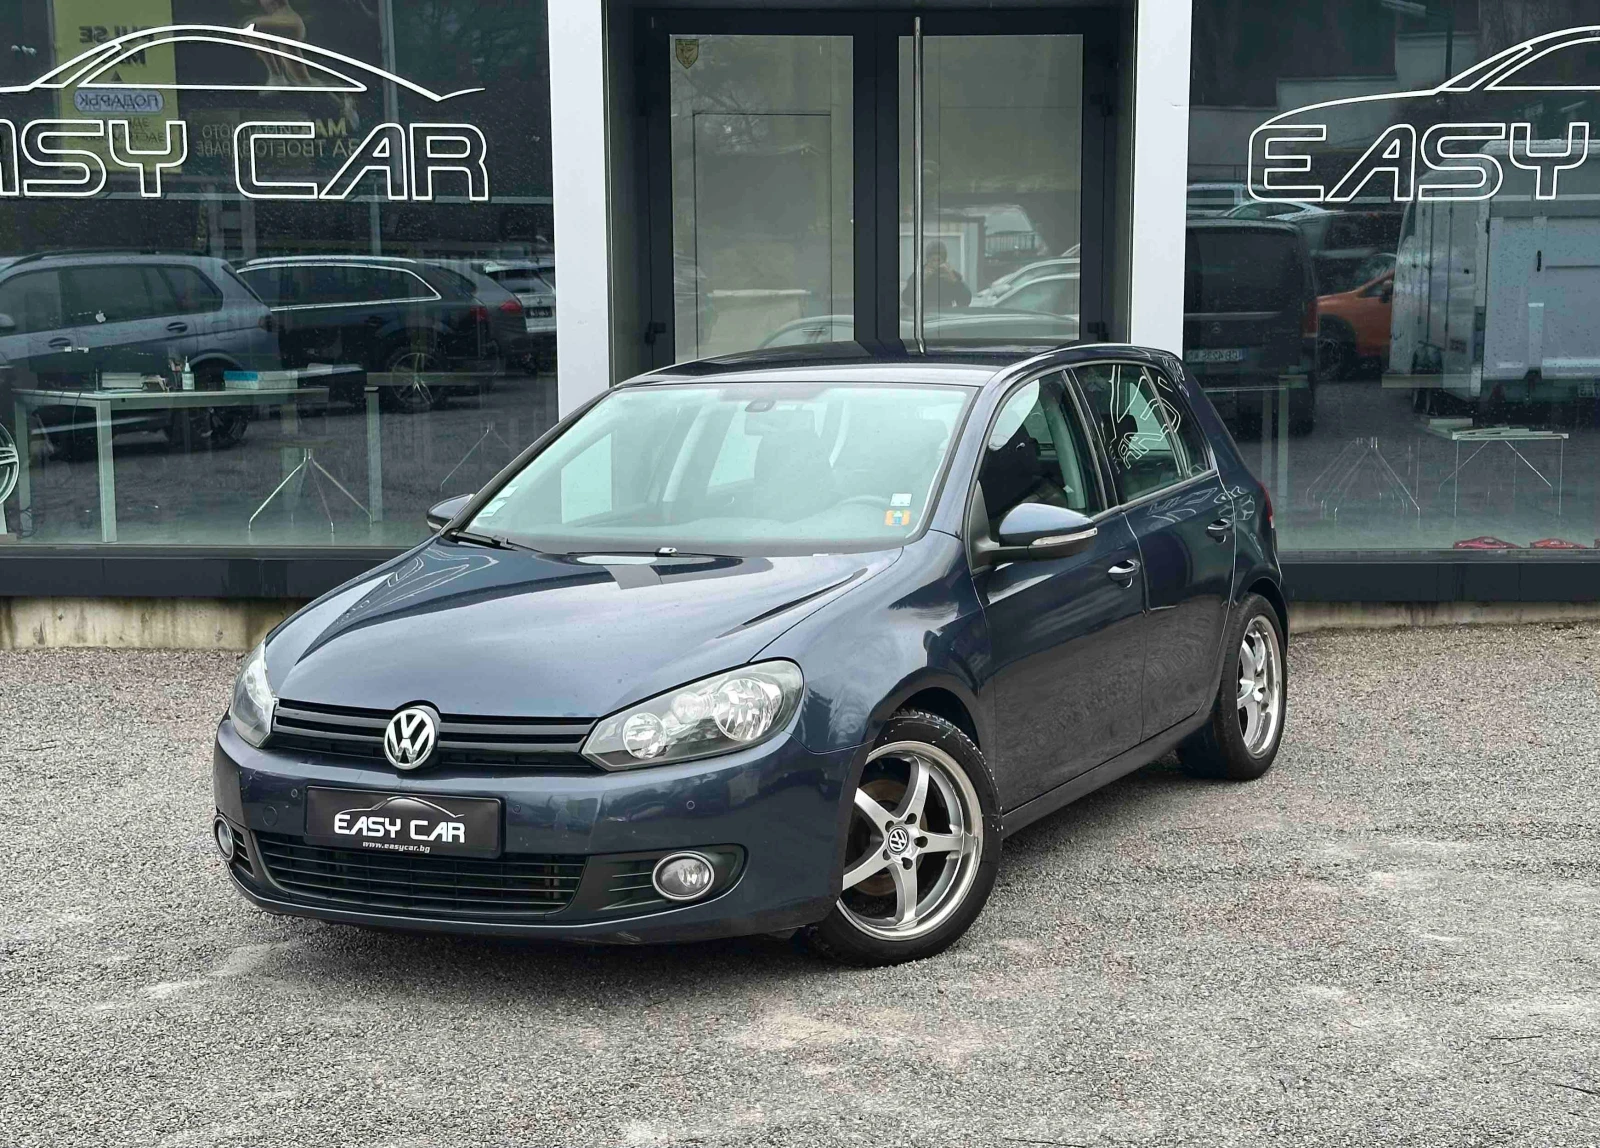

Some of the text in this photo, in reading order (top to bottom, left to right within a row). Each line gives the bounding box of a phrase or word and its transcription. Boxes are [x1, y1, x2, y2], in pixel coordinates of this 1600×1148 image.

[0, 118, 489, 201] SY CAR
[1247, 121, 1590, 202] EASY
[333, 813, 465, 843] EASY CAR
[362, 840, 431, 854] www.easycar.bg
